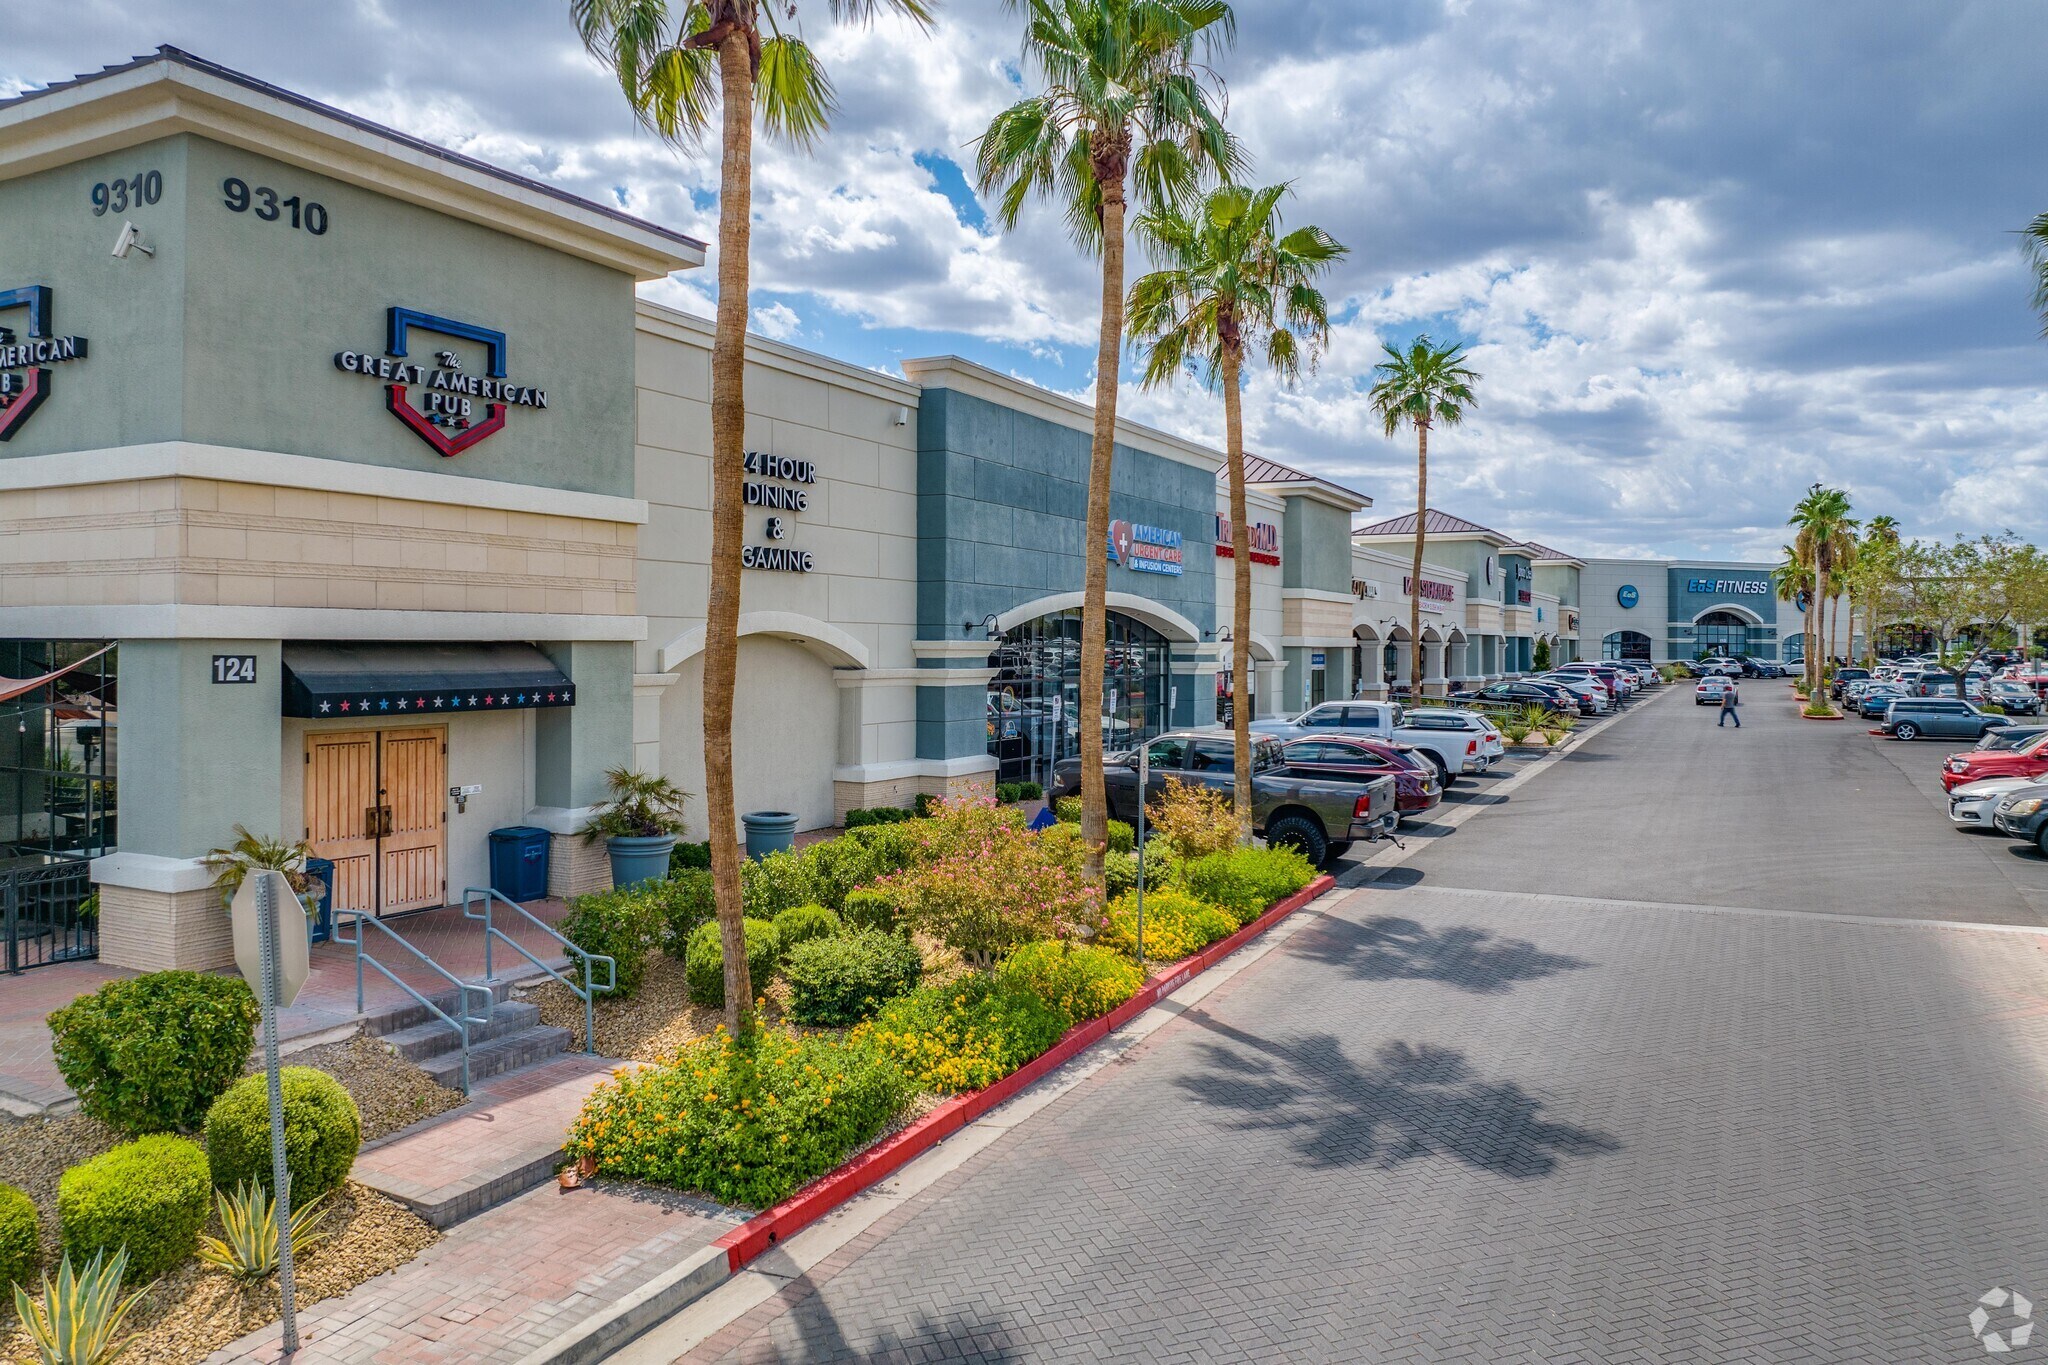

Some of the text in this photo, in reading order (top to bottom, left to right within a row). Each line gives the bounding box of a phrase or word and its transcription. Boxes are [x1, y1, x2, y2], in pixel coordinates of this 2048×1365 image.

[91, 169, 163, 217] 9310
[223, 177, 328, 235] 9310
[440, 350, 463, 369] The
[338, 350, 548, 409] GREAT AMERICAN
[429, 392, 472, 416] PUB
[766, 454, 817, 484] HOUR
[747, 482, 809, 512] DINING
[773, 517, 785, 540] &
[1134, 524, 1183, 548] AMERICAN
[741, 545, 814, 573] GAMING
[1134, 543, 1183, 563] URGENT CARE
[1138, 560, 1162, 572] INFUSION
[1162, 562, 1183, 574] CENTERS
[1715, 580, 1768, 593] FITNESS
[214, 657, 255, 681] 124
